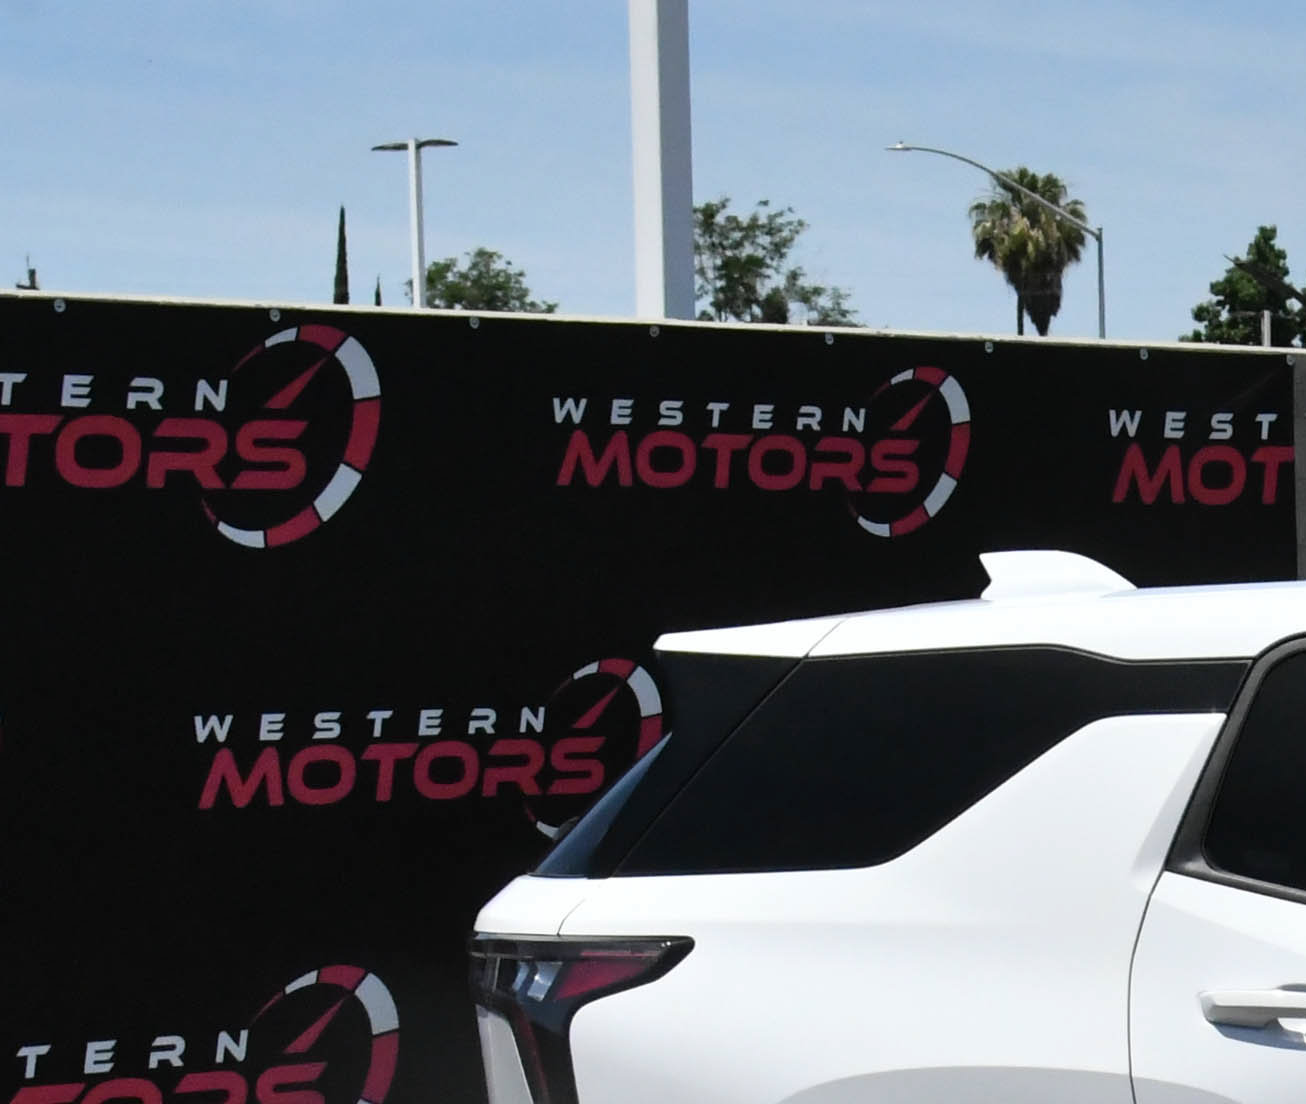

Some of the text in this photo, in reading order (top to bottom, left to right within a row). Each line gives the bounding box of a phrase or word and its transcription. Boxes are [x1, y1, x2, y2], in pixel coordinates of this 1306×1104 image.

[552, 397, 866, 433] WESTERN
[1108, 409, 1278, 440] WEST
[556, 430, 920, 493] MOTORS
[1112, 443, 1296, 505] MOT
[193, 706, 546, 743] WESTERN
[198, 737, 606, 810] MOTORS
[16, 1029, 249, 1079] TERN
